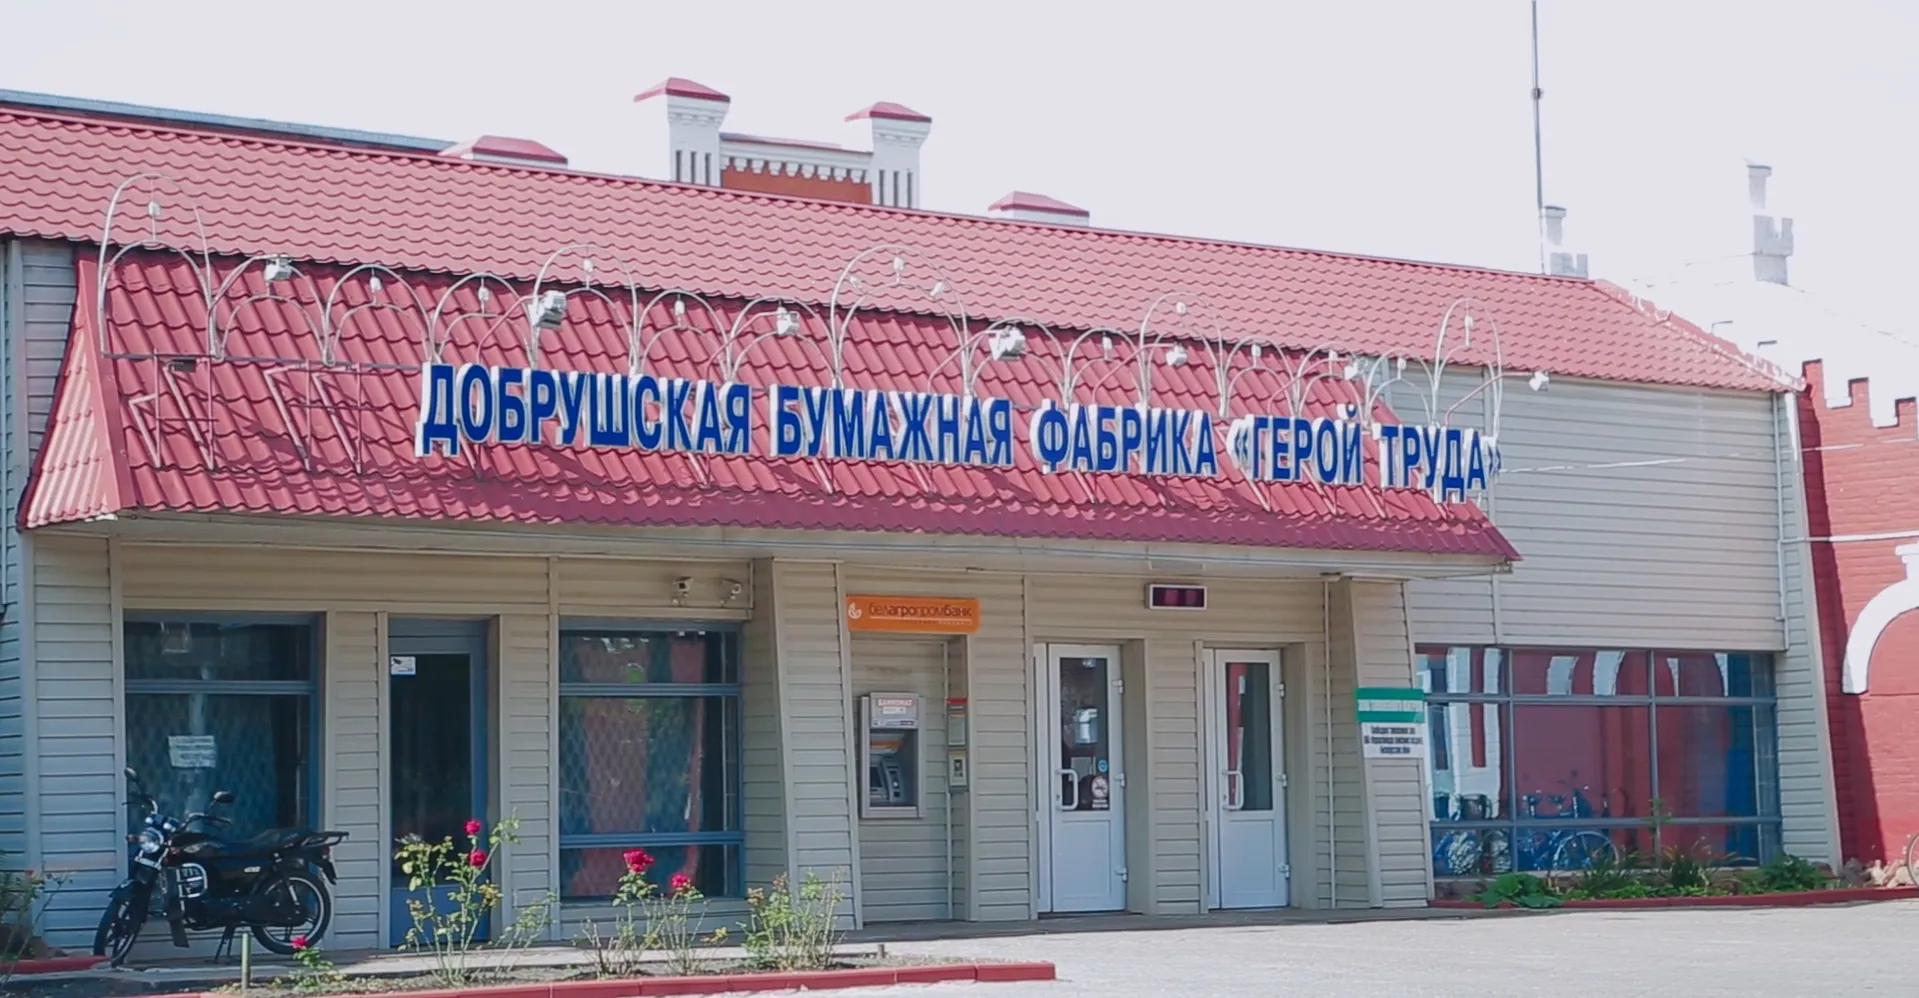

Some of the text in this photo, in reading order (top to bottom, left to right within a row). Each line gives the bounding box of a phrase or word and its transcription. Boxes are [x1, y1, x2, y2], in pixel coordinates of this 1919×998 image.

[418, 362, 1503, 503] ДОБРУШСКАЯ БУМАЖНАЯ ФАБРИКА «ГЕРОЙ ТРУДА»
[867, 602, 972, 618] белагропромбанк
